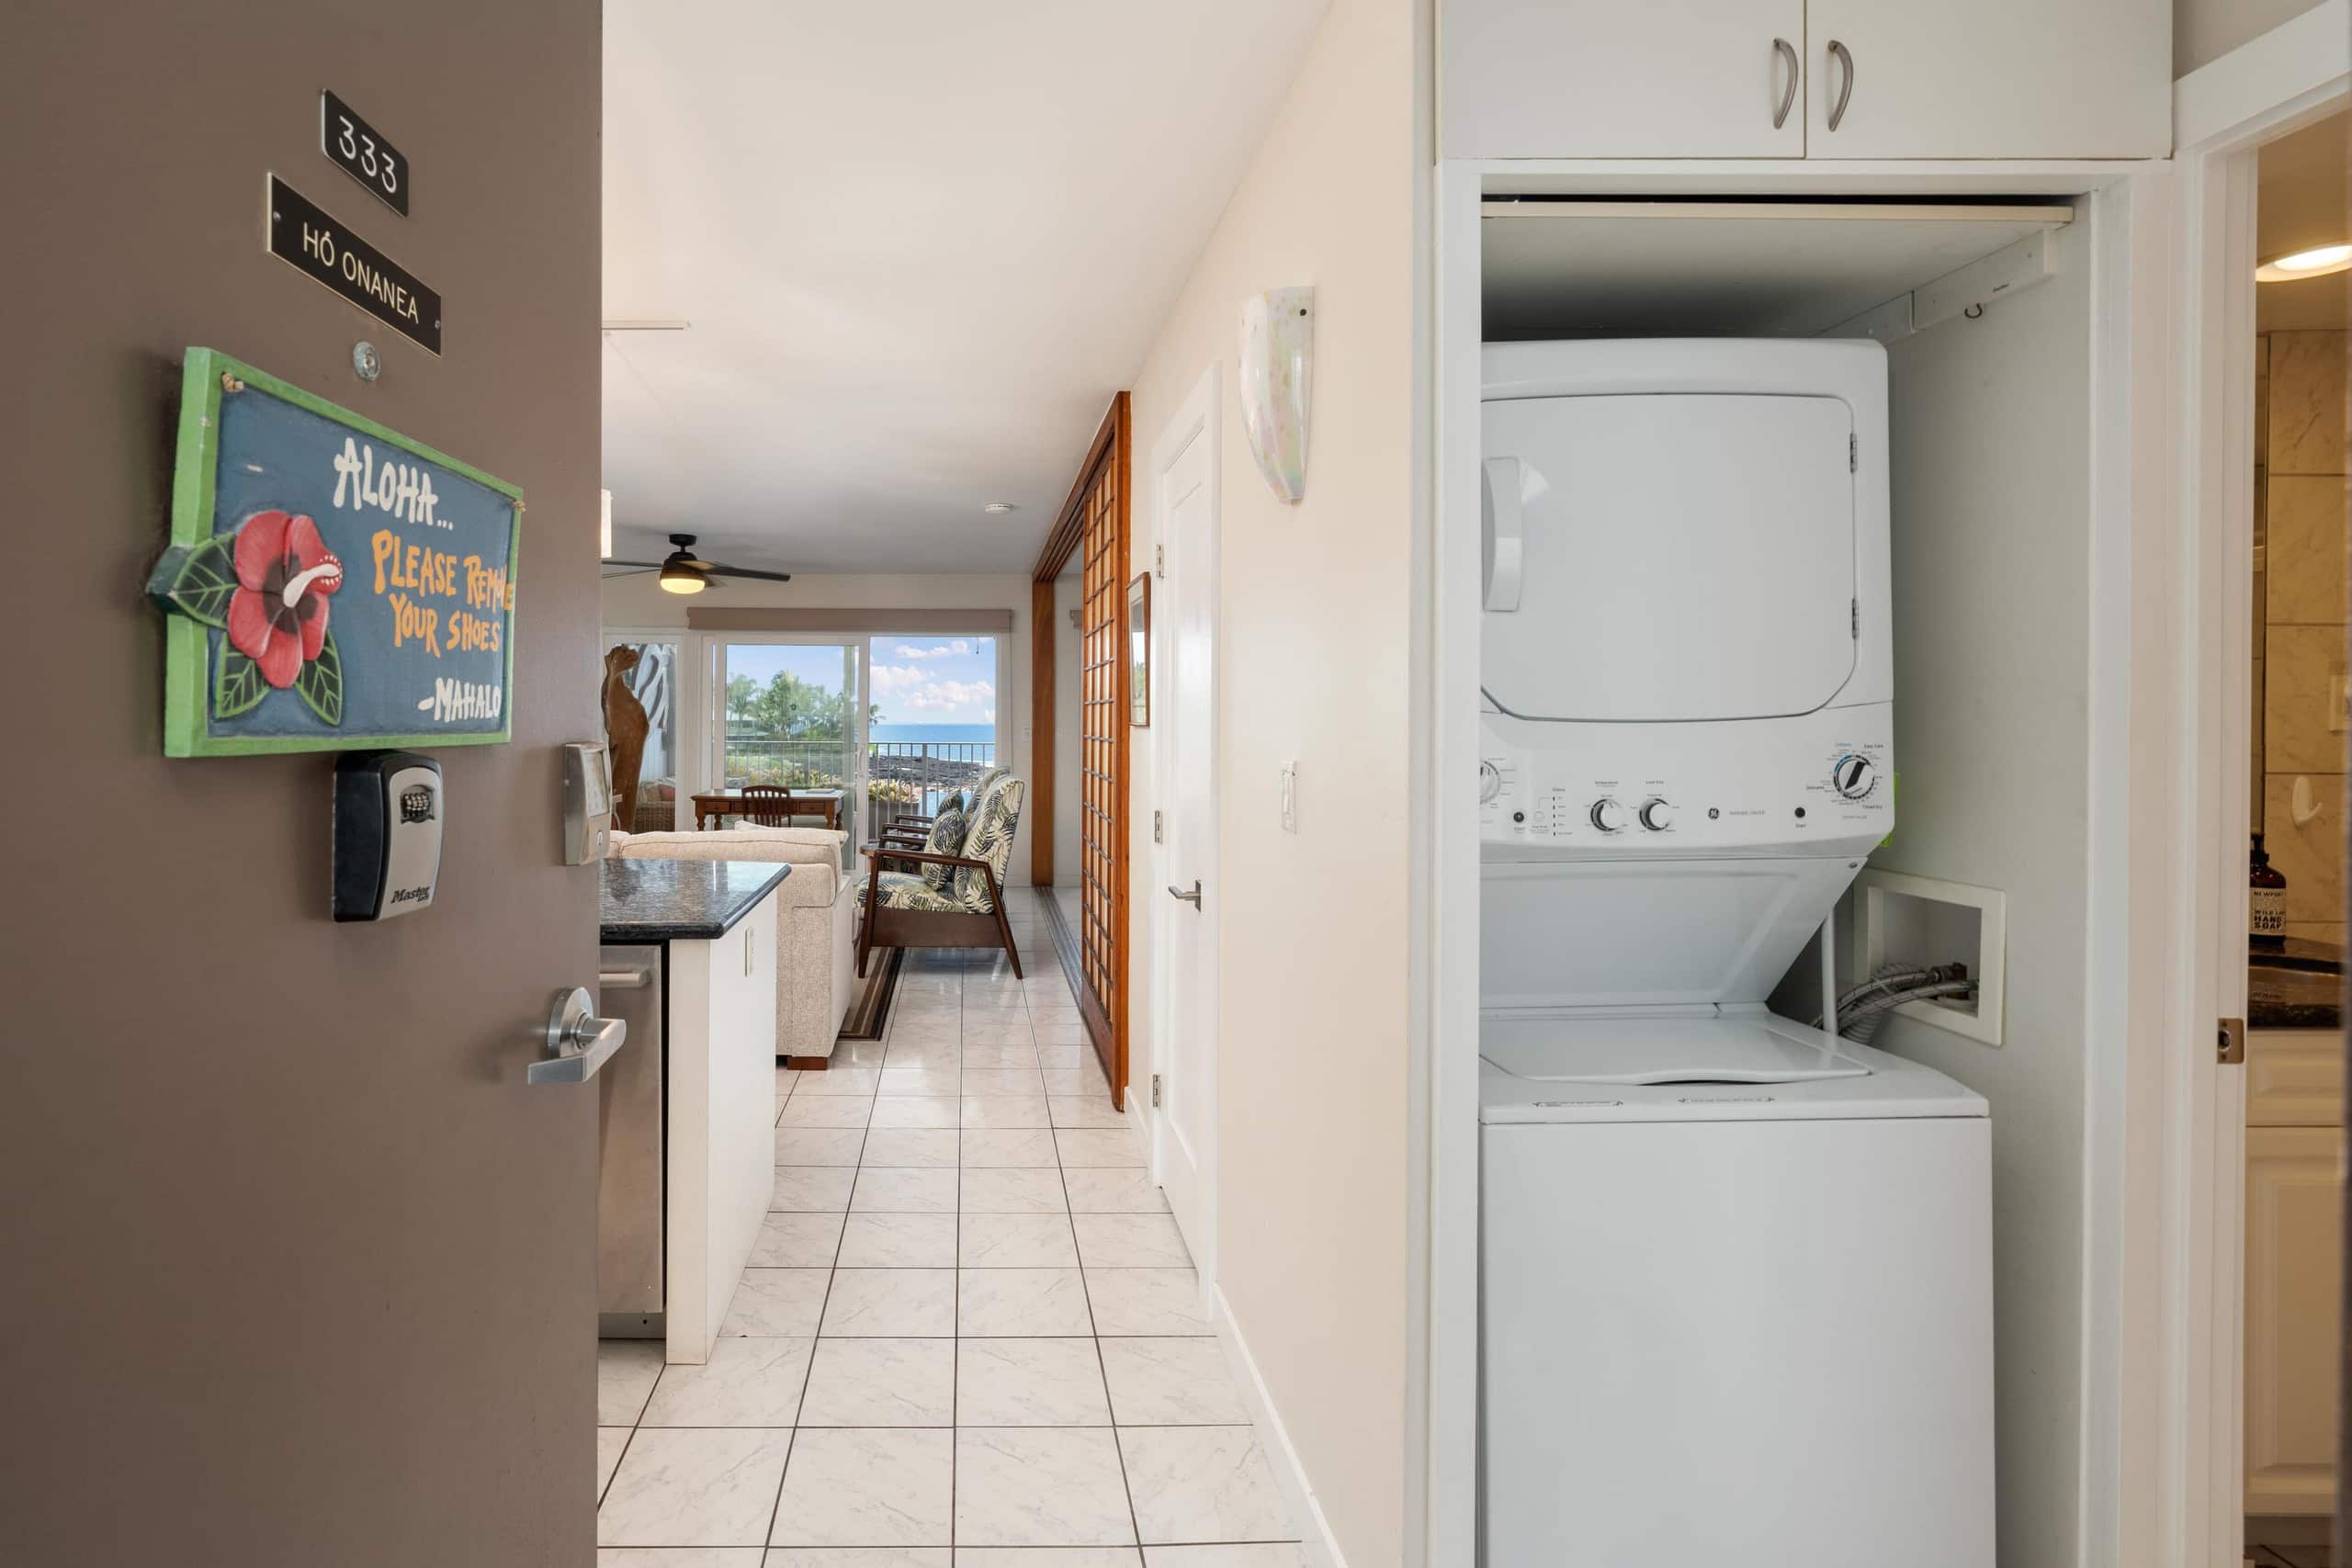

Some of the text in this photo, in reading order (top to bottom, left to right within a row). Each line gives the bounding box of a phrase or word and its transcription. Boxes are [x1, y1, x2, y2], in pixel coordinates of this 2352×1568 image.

[338, 115, 397, 194] 333
[342, 251, 419, 324] ONANEA
[372, 529, 458, 597] PLEASE
[389, 593, 501, 659] YOUR SHOES
[390, 886, 430, 904] Master
